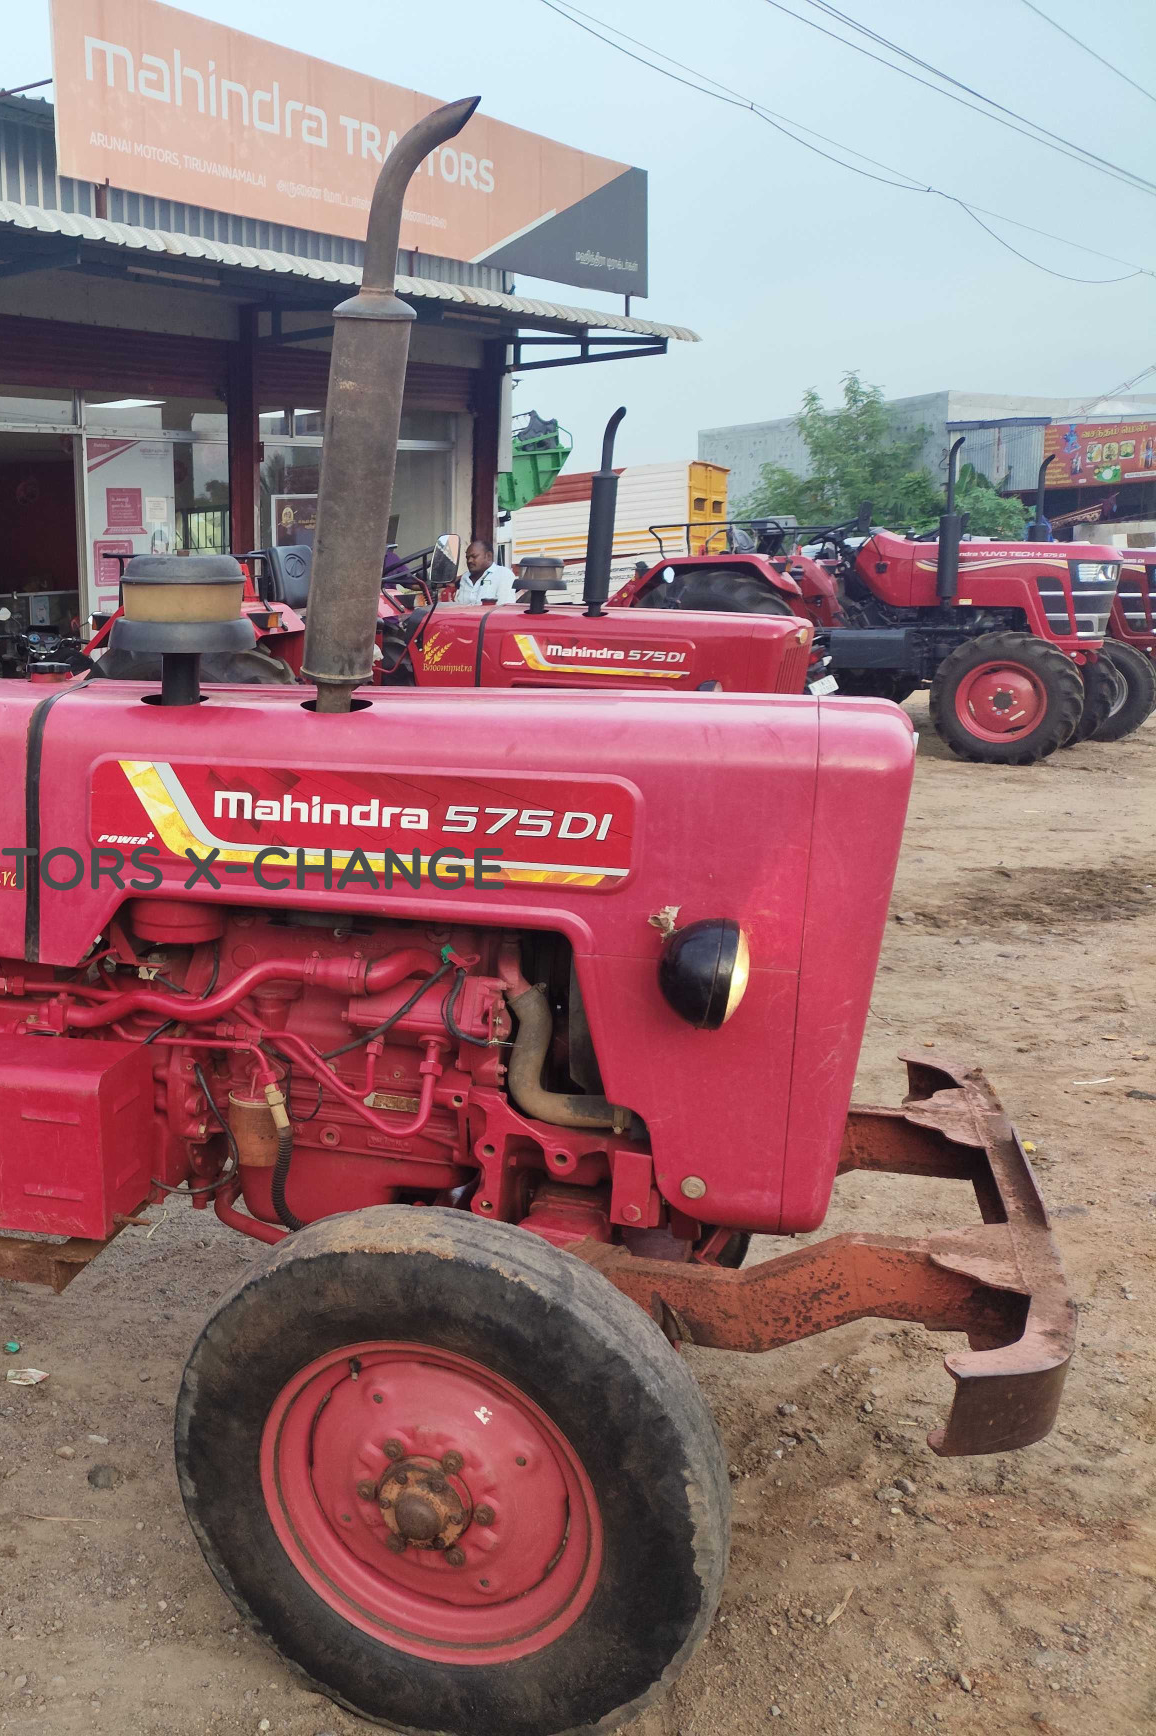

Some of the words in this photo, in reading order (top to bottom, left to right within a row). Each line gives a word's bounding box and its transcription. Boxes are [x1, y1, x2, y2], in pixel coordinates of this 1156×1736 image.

[89, 131, 132, 154] ARUNAI
[182, 154, 267, 188] TIRUVANNAMALAI
[339, 114, 495, 193] TRATORS
[546, 644, 625, 660] Mahindra
[213, 790, 430, 831] Mahindra
